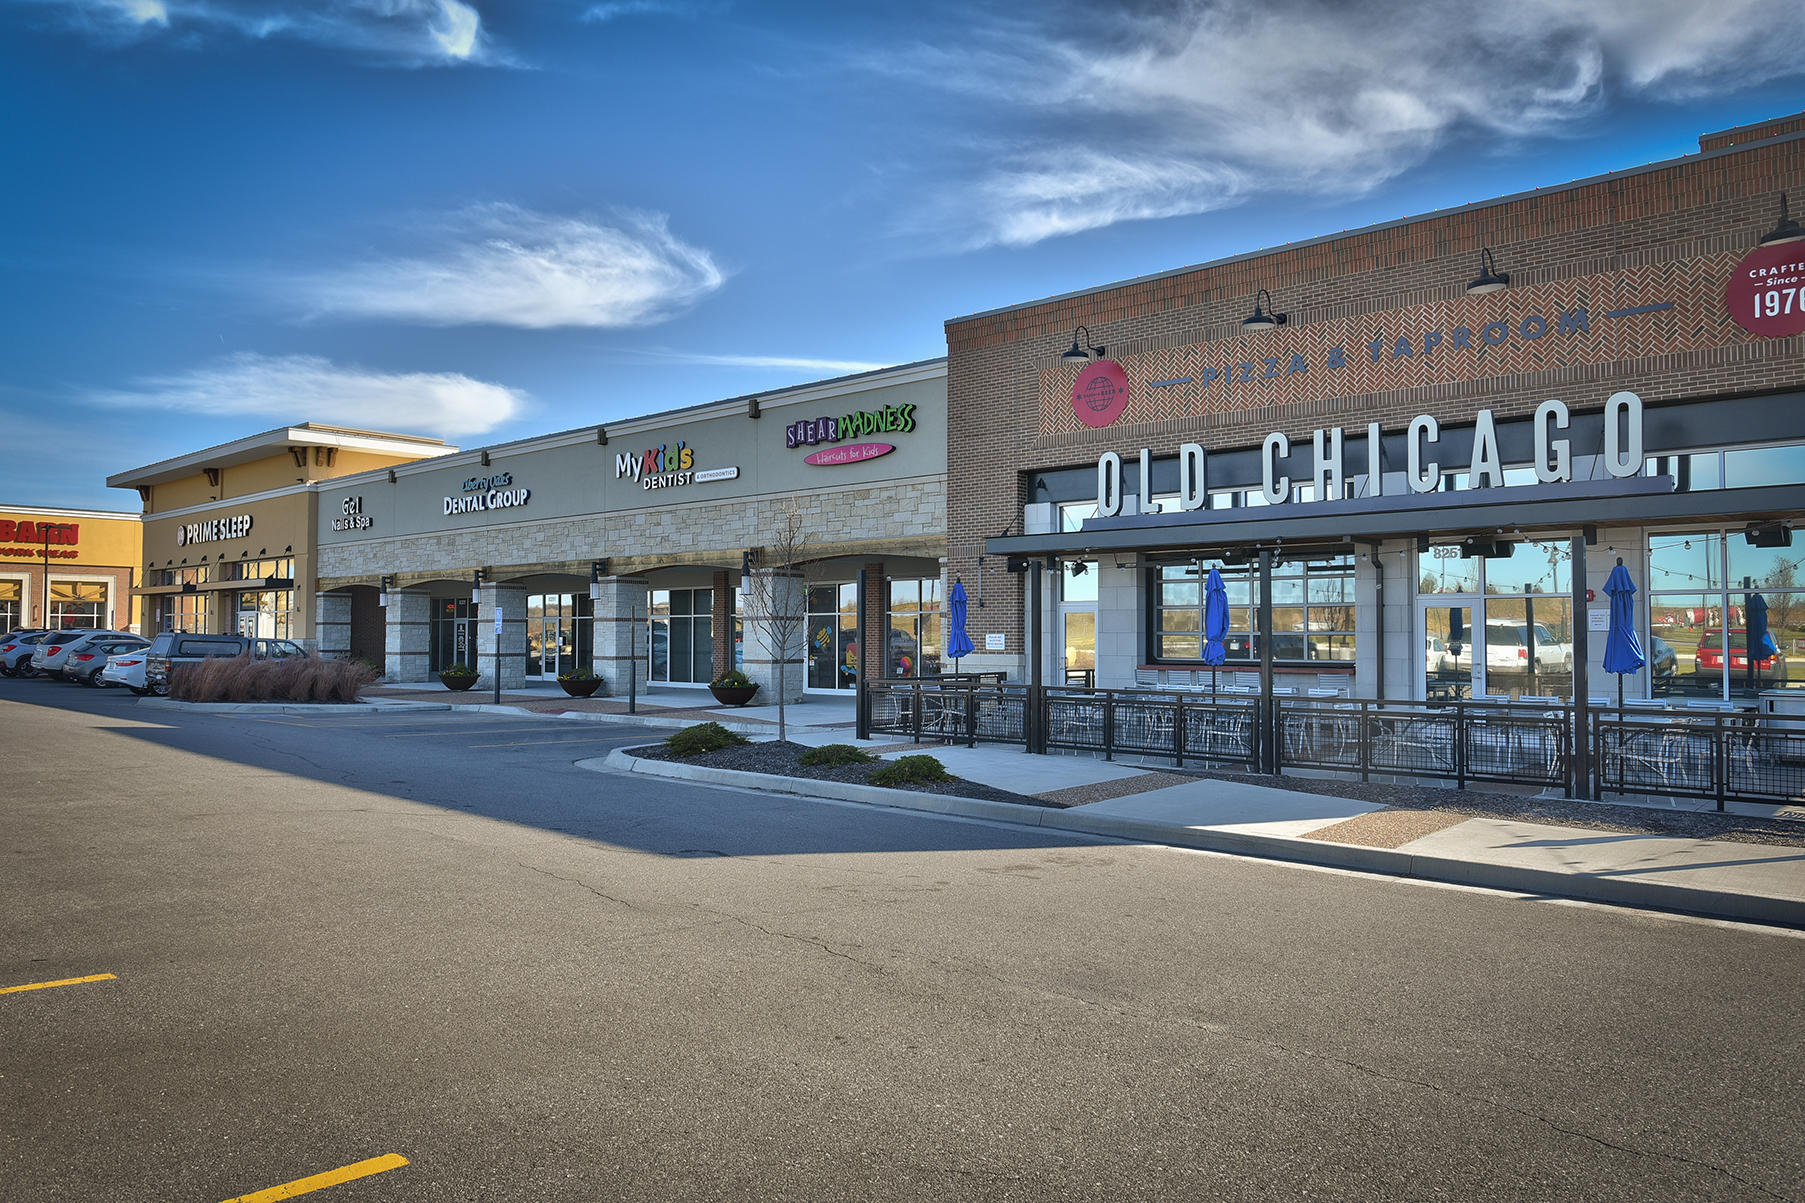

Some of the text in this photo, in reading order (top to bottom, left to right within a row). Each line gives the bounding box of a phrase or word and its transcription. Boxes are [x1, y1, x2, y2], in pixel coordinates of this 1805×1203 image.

[1766, 276, 1798, 286] Since
[1202, 307, 1590, 388] PIZZA & TAPROOM
[787, 403, 914, 446] SHEAR MADNESS
[816, 444, 879, 464] Haircuts for Kids
[1097, 391, 1643, 517] OLD CHICAGO
[644, 472, 692, 490] DENTIST
[701, 469, 736, 480] ORTHODONTICS
[342, 496, 359, 515] Gel
[443, 488, 528, 515] DENTAL GROUP
[0, 519, 79, 545] BARN
[187, 514, 251, 545] PRIME SLEEP
[350, 516, 355, 529] &
[355, 515, 371, 530] Spa
